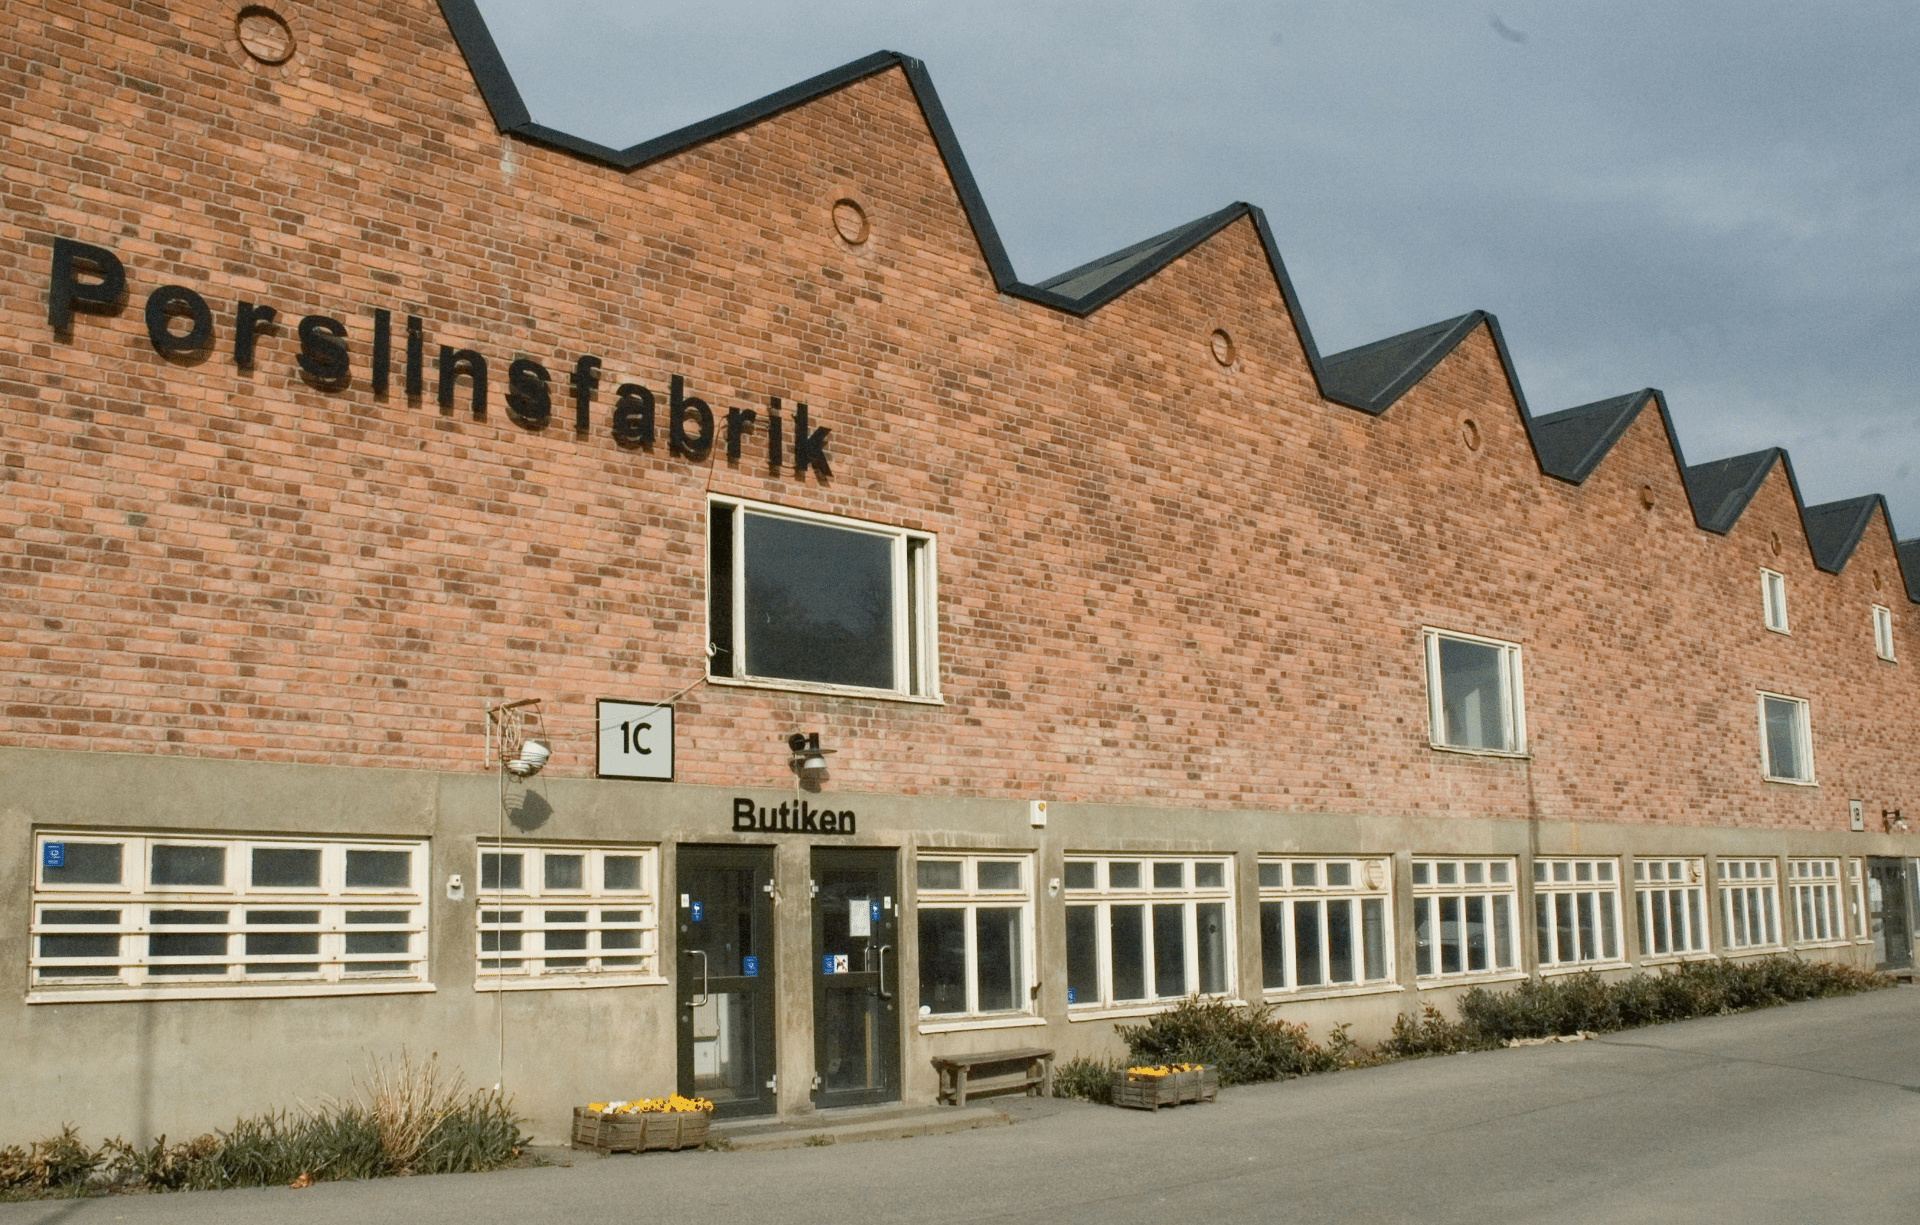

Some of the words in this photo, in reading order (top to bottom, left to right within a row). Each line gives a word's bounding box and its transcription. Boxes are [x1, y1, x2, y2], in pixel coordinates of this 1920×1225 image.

[48, 236, 834, 478] Porslinsfabrik
[620, 721, 652, 755] 1C
[732, 797, 856, 835] Butiken
